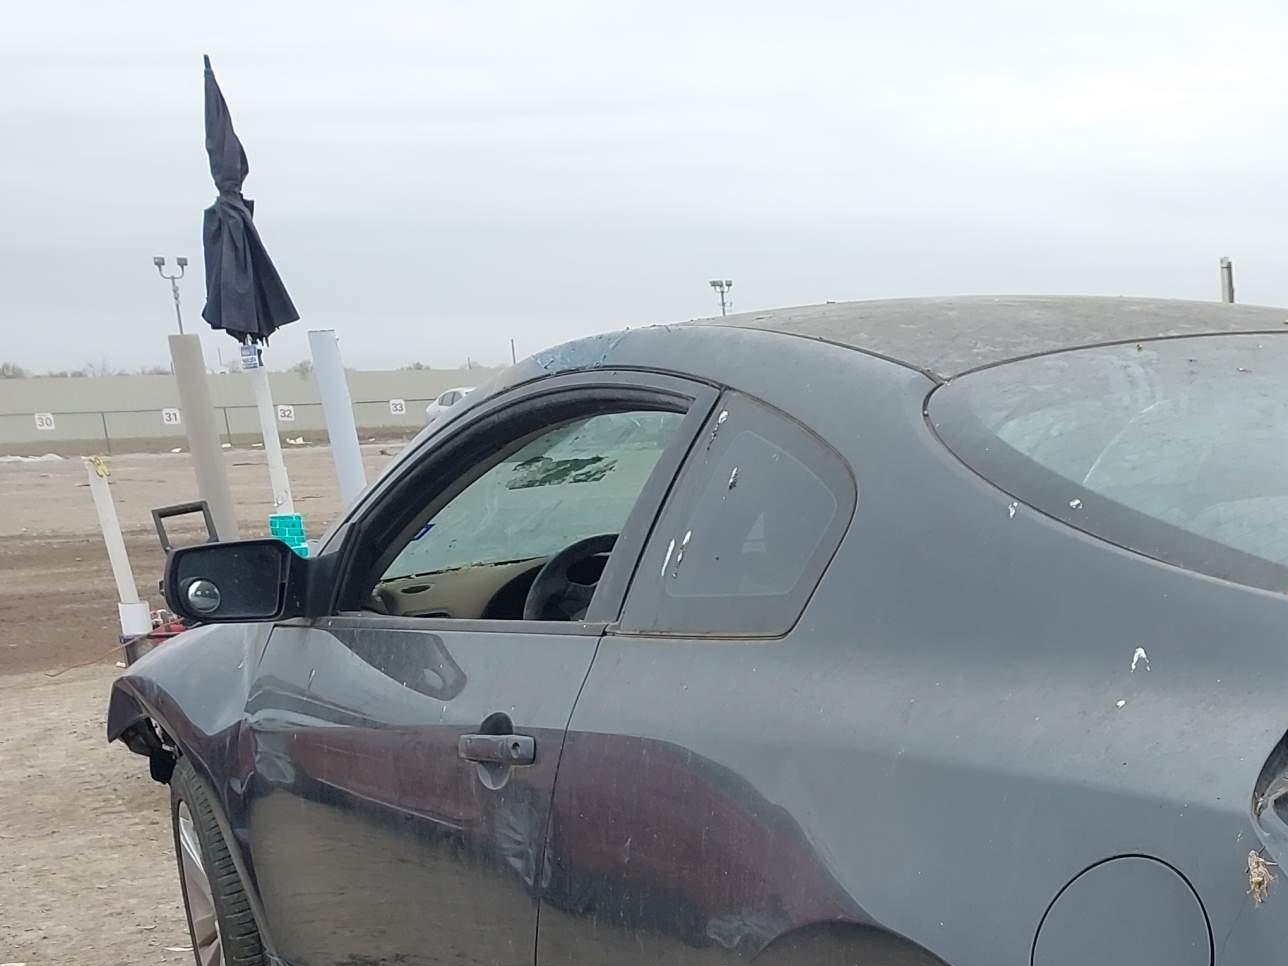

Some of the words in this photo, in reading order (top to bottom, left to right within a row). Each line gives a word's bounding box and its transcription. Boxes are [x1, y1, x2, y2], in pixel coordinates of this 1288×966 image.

[391, 402, 404, 412] 33
[164, 412, 177, 422] 31
[279, 408, 293, 418] 32
[37, 416, 53, 428] 30
